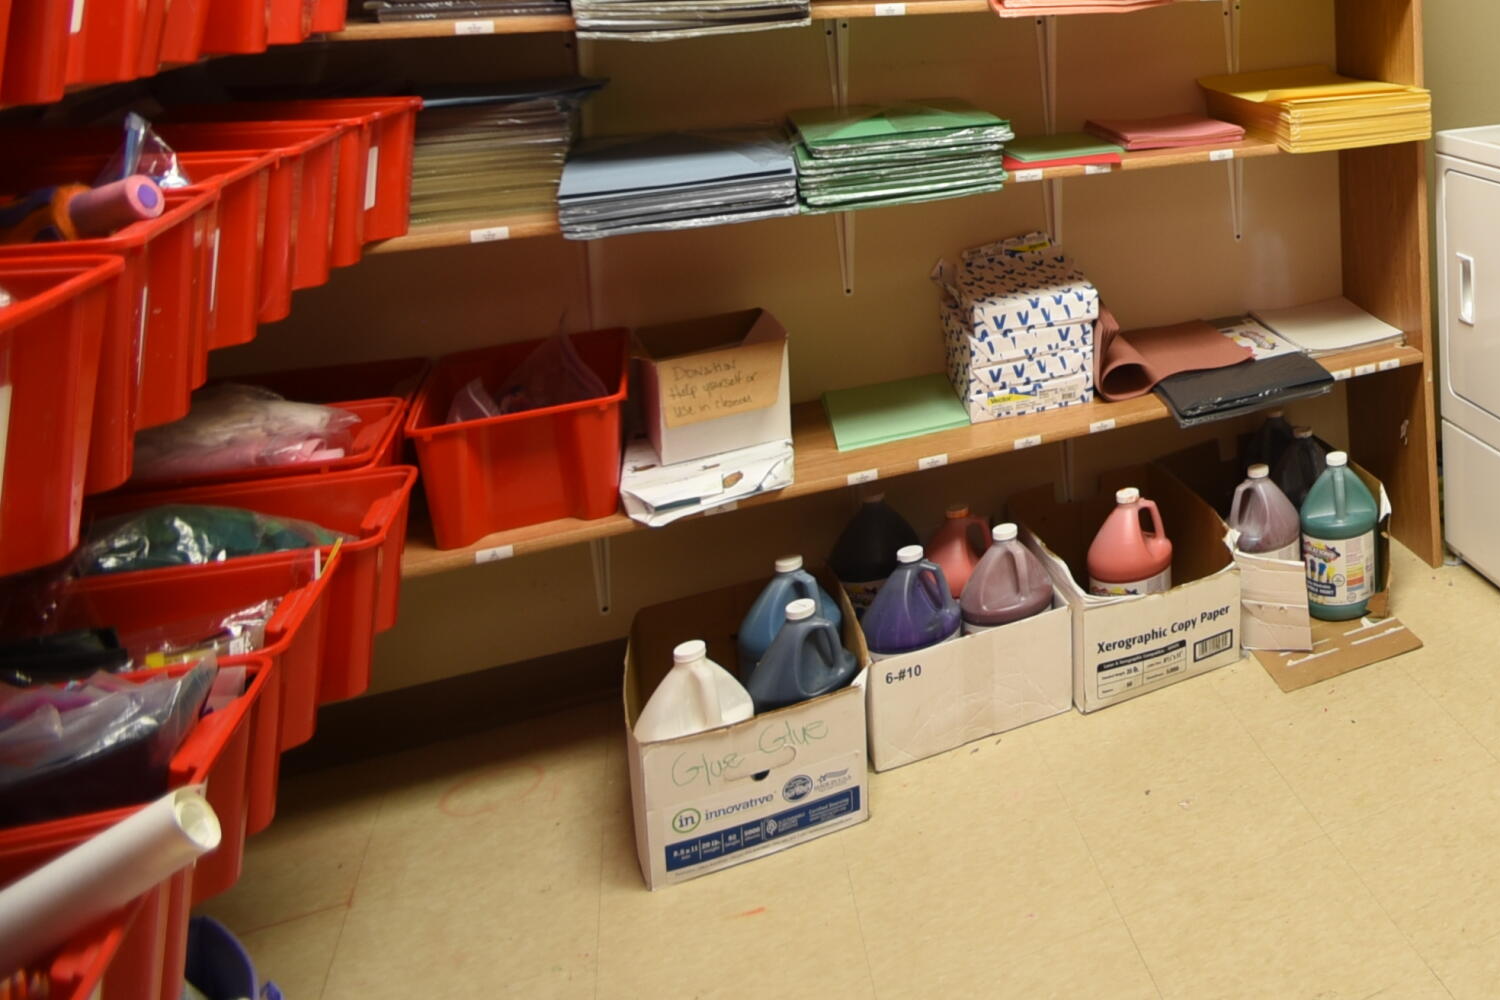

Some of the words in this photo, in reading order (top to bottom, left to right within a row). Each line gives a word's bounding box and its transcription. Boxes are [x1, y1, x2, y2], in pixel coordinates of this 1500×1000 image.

[669, 383, 697, 400] Help
[1097, 627, 1168, 654] Xerographic
[1170, 617, 1197, 634] Copy
[1200, 605, 1230, 623] Paper
[885, 664, 922, 685] 6-#10
[671, 751, 744, 788] Glue
[758, 720, 829, 754] Glue
[678, 811, 696, 828] in
[704, 793, 774, 821] innovative
